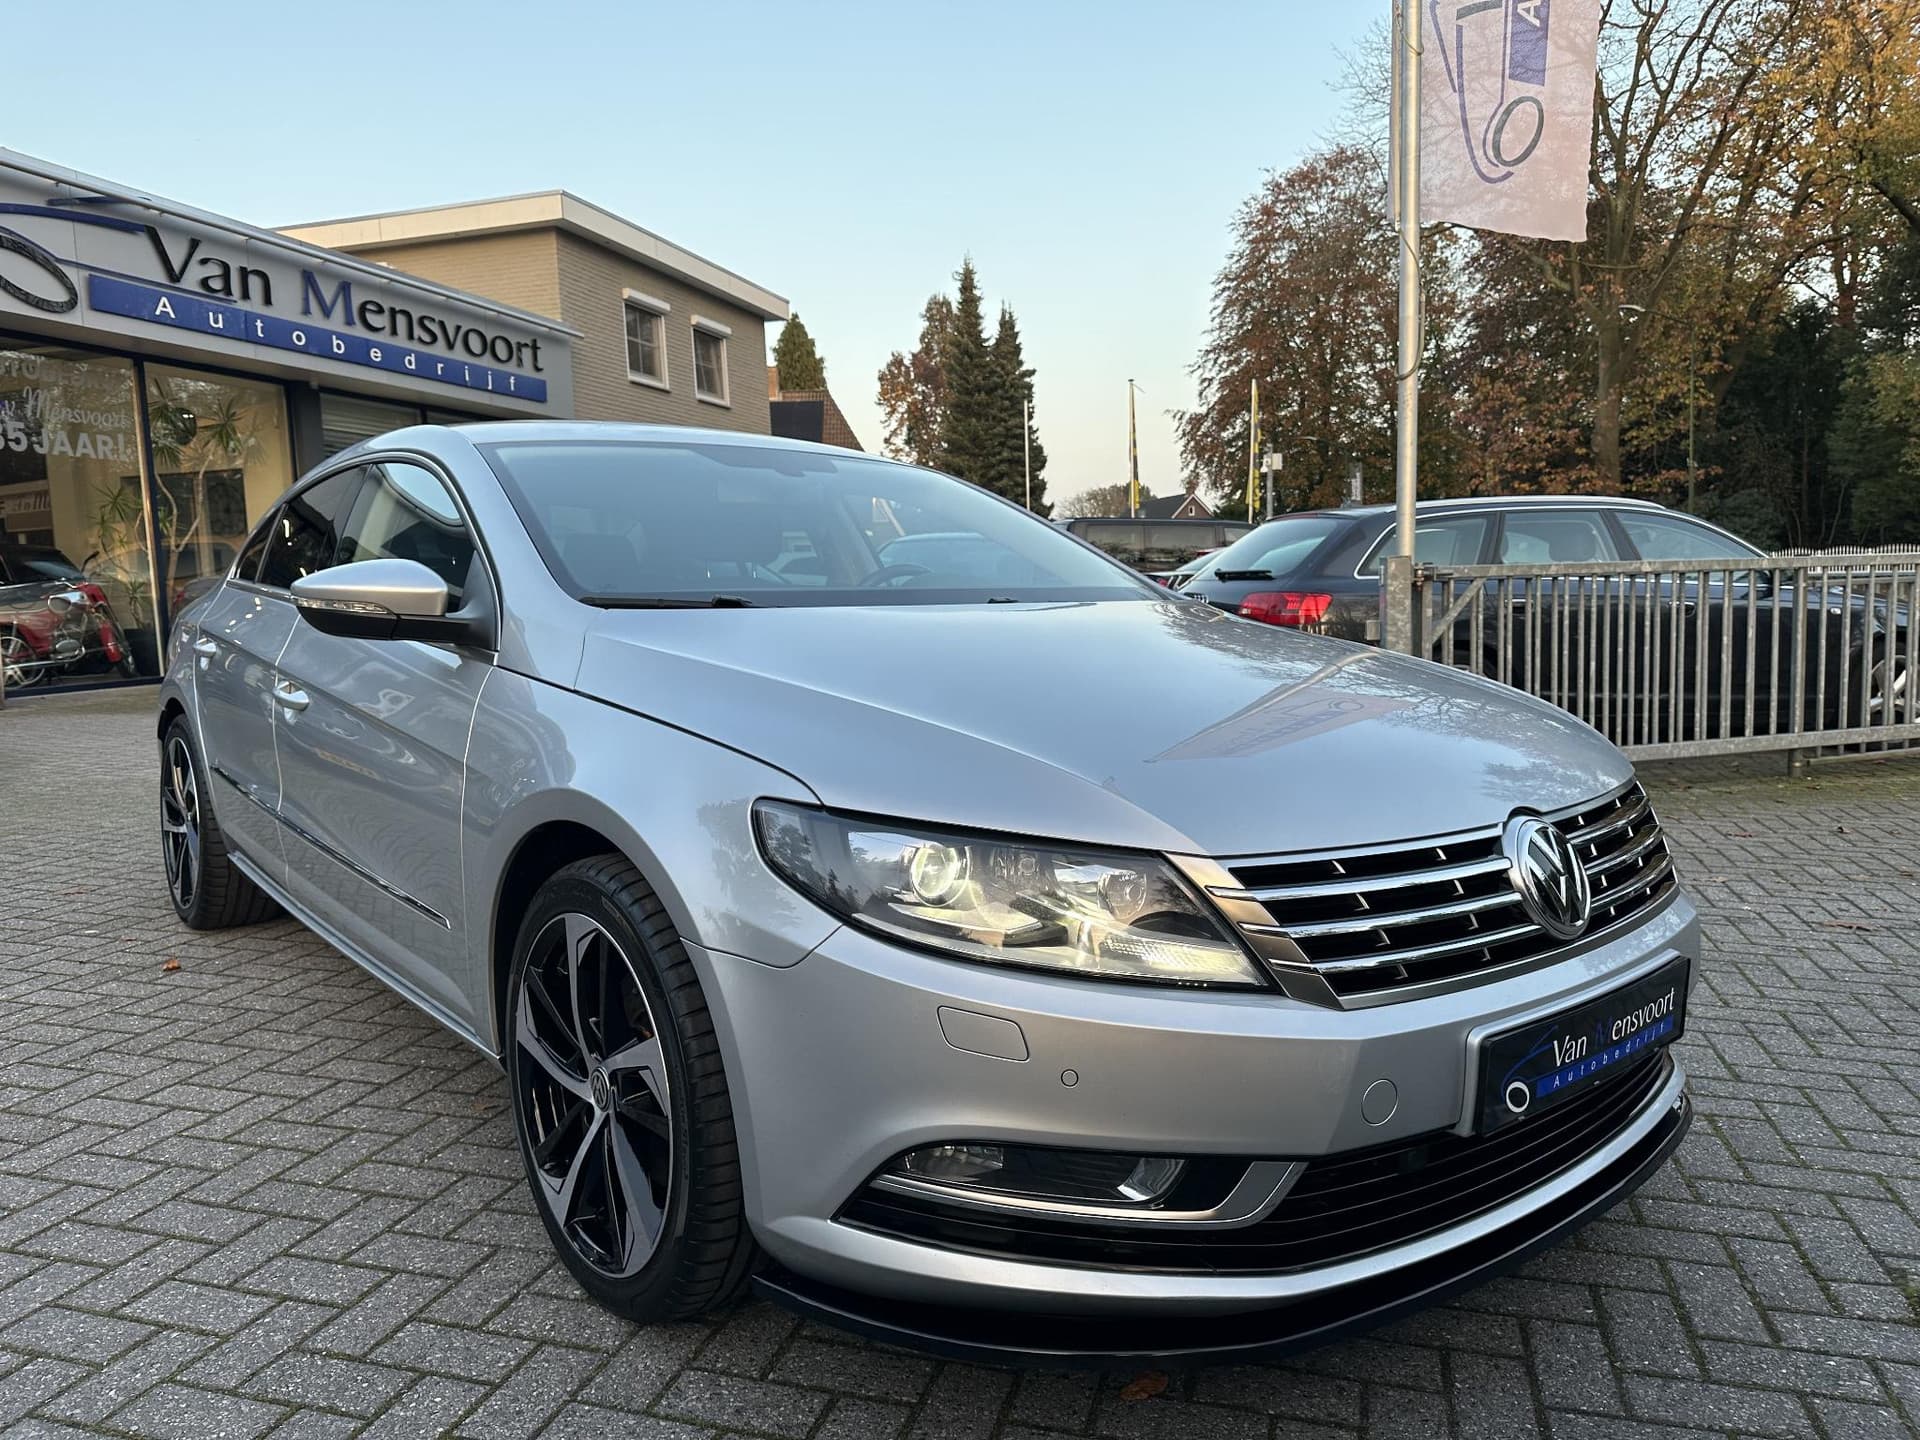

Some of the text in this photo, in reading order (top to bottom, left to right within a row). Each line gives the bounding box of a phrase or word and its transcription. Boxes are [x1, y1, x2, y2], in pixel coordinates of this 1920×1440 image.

[145, 224, 544, 372] Van Mensvoort
[155, 296, 516, 390] Autobedrijf
[1553, 987, 1675, 1067] Van Mensvoort
[1553, 1022, 1665, 1088] Autobedrijf
